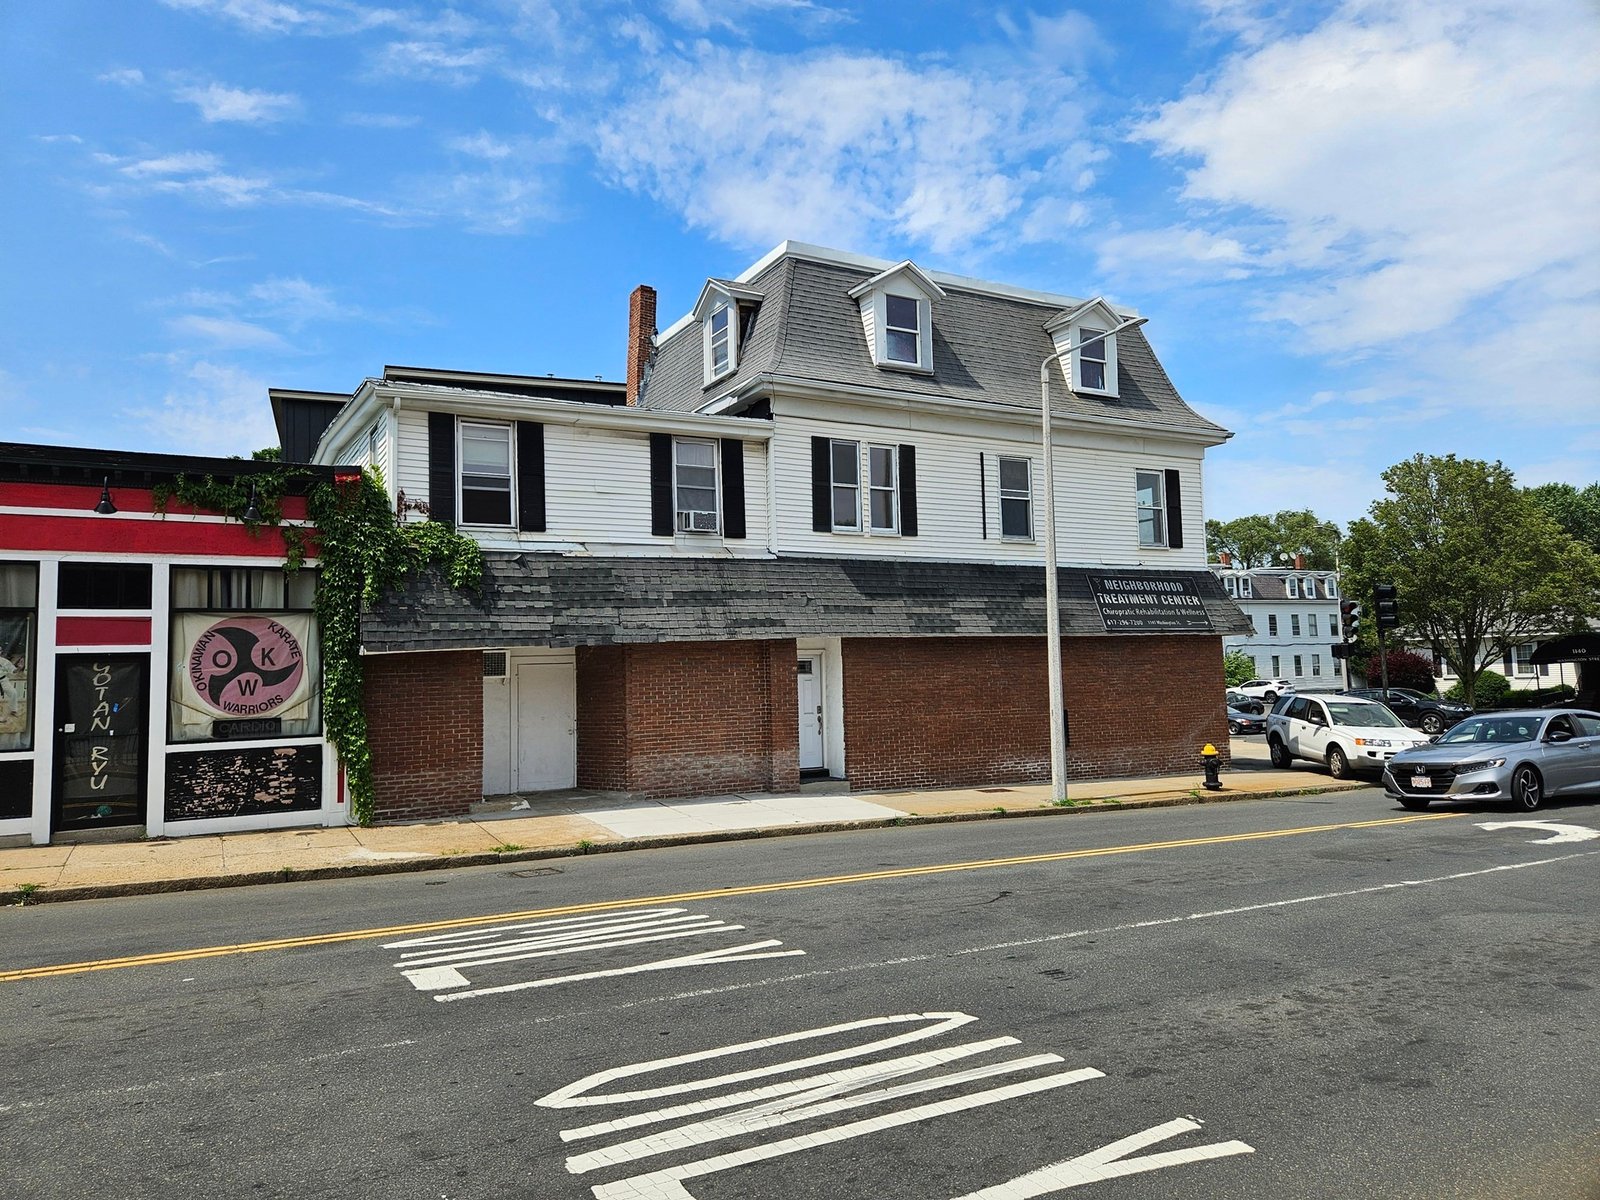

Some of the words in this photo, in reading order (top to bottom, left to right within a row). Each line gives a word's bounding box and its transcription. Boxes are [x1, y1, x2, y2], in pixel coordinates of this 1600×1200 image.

[1104, 580, 1183, 591] NEIGHBORHOOD
[1097, 593, 1158, 605] TREATMENT
[1161, 595, 1200, 606] CENTER
[1135, 608, 1175, 616] Rehabilitation
[1180, 608, 1206, 616] Wellness
[267, 622, 301, 659] KARATE
[191, 630, 216, 691] OKINAWAN
[212, 649, 232, 668] O
[261, 647, 276, 666] K
[237, 679, 259, 696] W
[223, 695, 284, 714] WARRIORS
[219, 720, 276, 734] CARDIO
[90, 746, 109, 790] RYU
[378, 908, 807, 1002] ONLY
